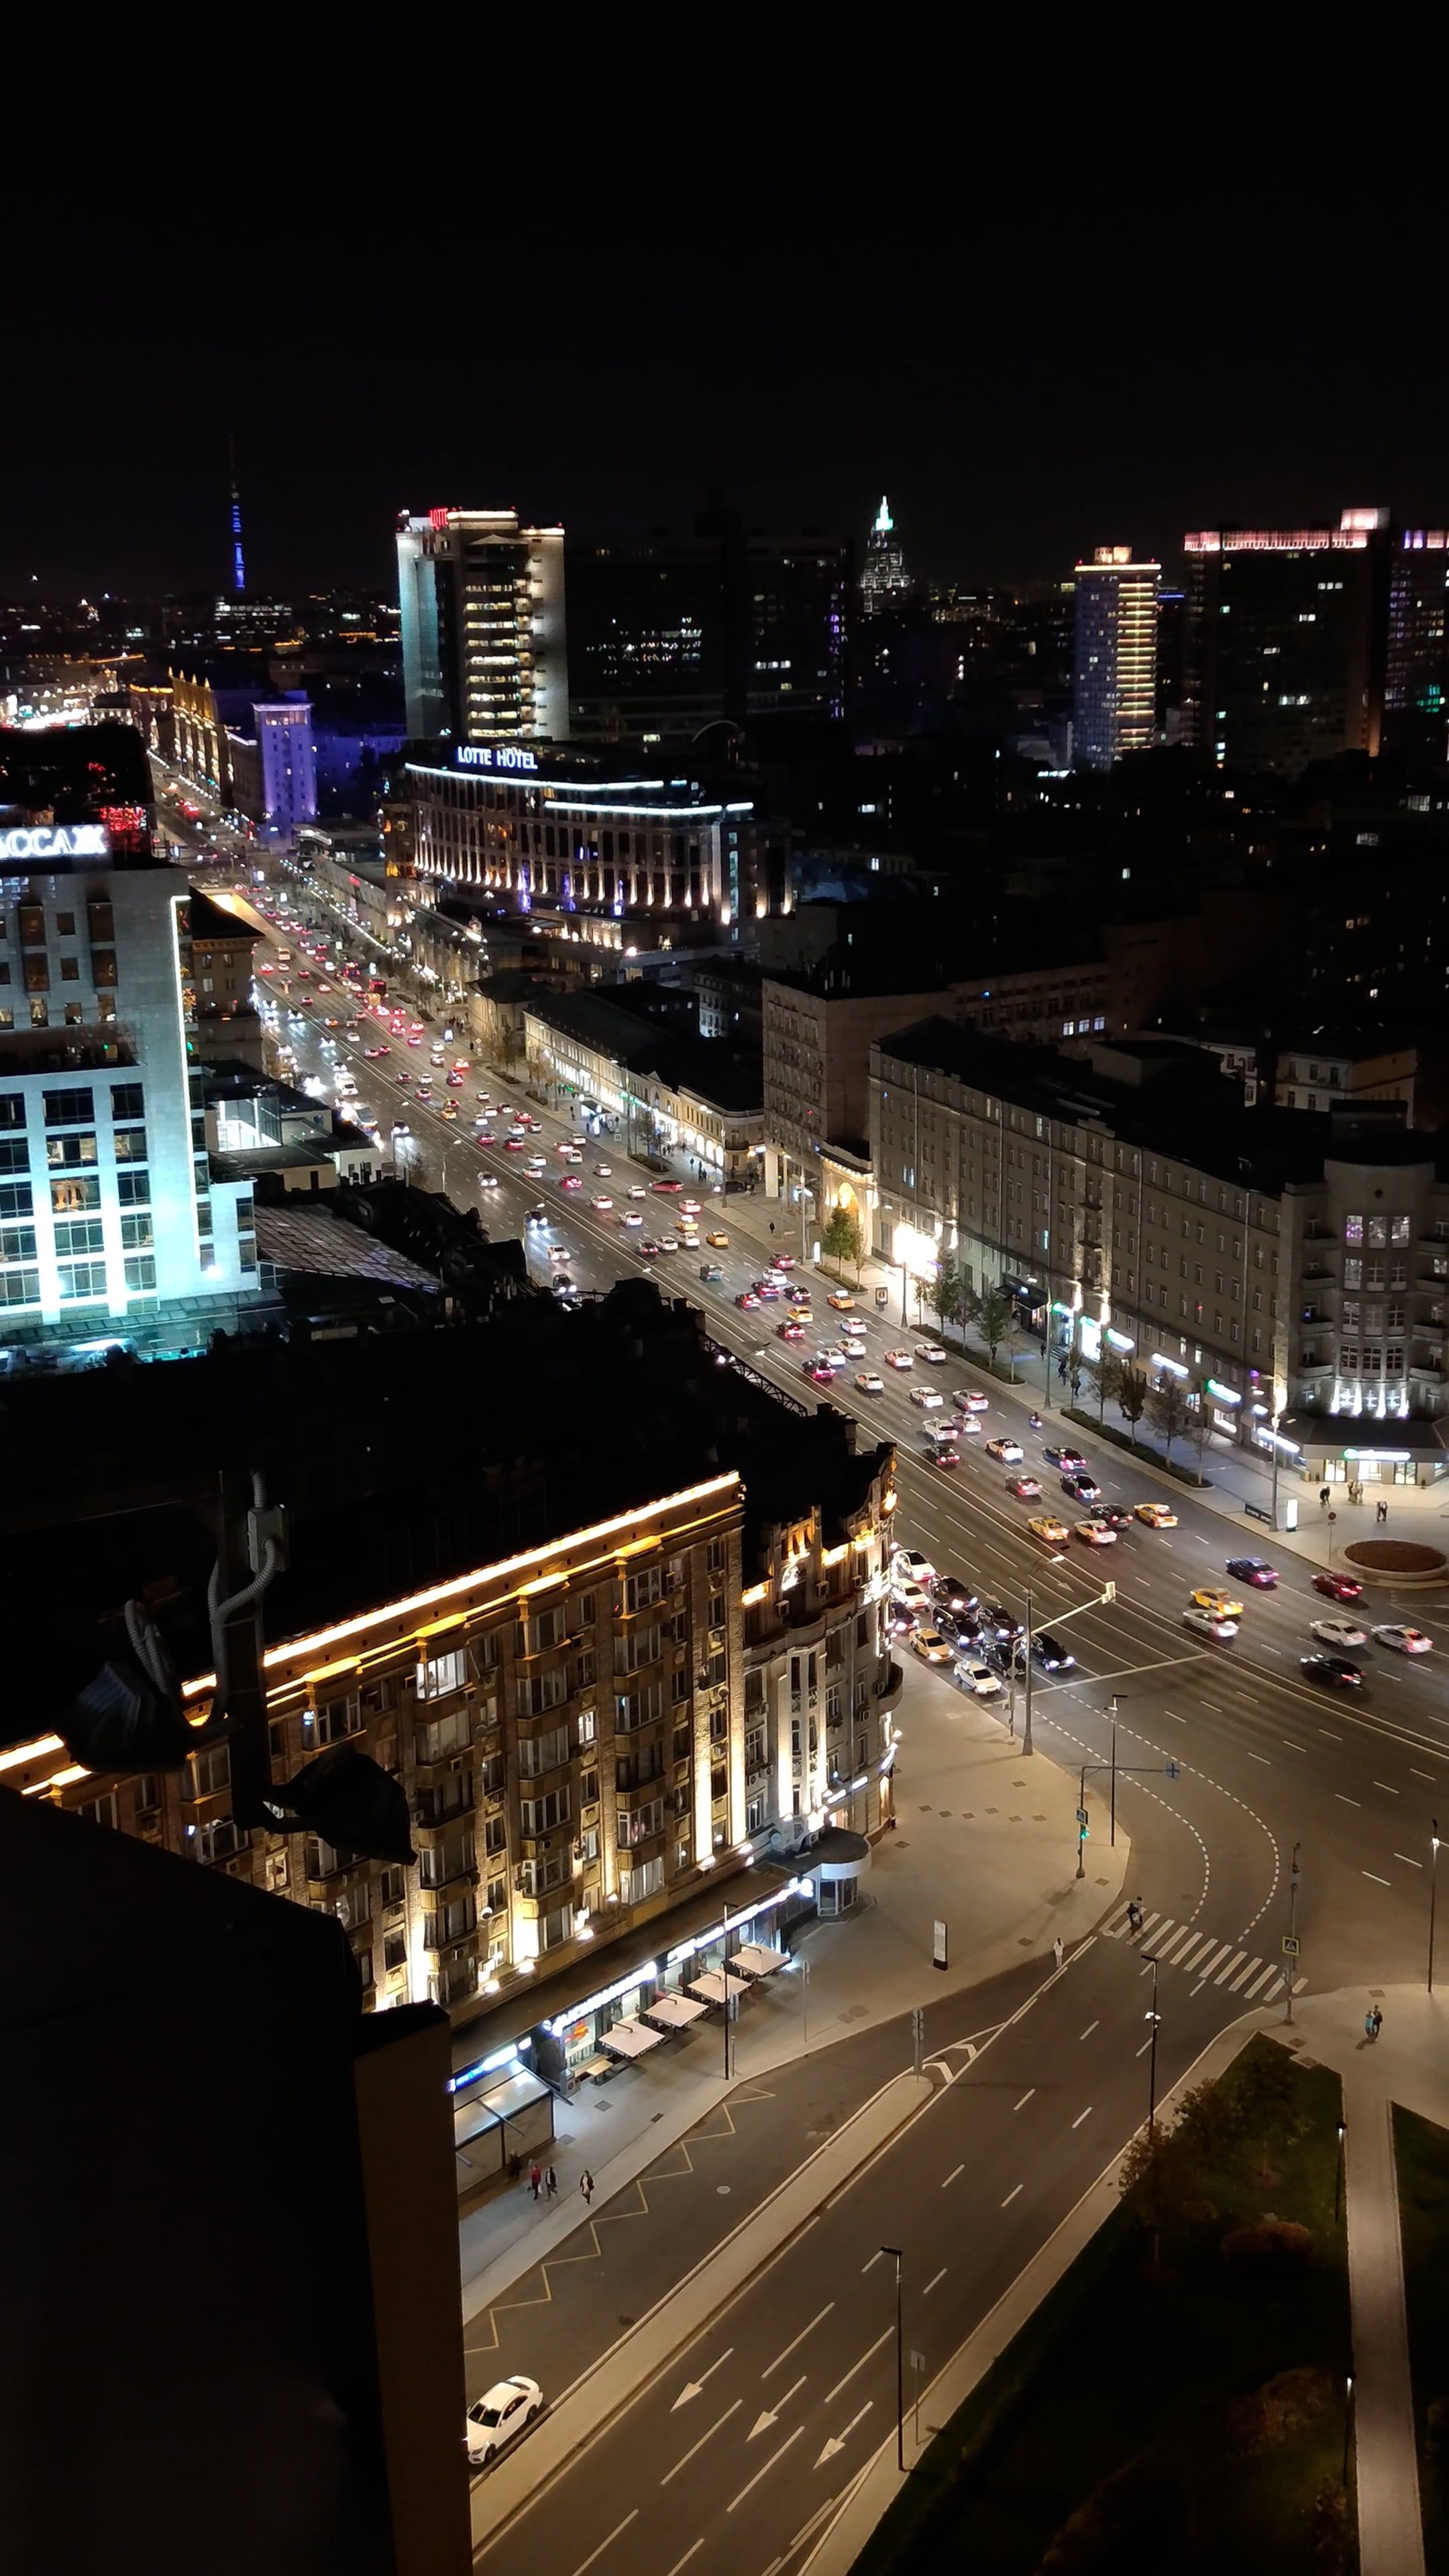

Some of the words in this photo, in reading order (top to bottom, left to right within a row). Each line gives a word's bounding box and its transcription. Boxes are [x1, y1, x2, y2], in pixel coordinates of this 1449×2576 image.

[430, 508, 448, 527] LOTTE
[458, 746, 492, 765] LOTTE
[496, 747, 538, 769] HOTEL
